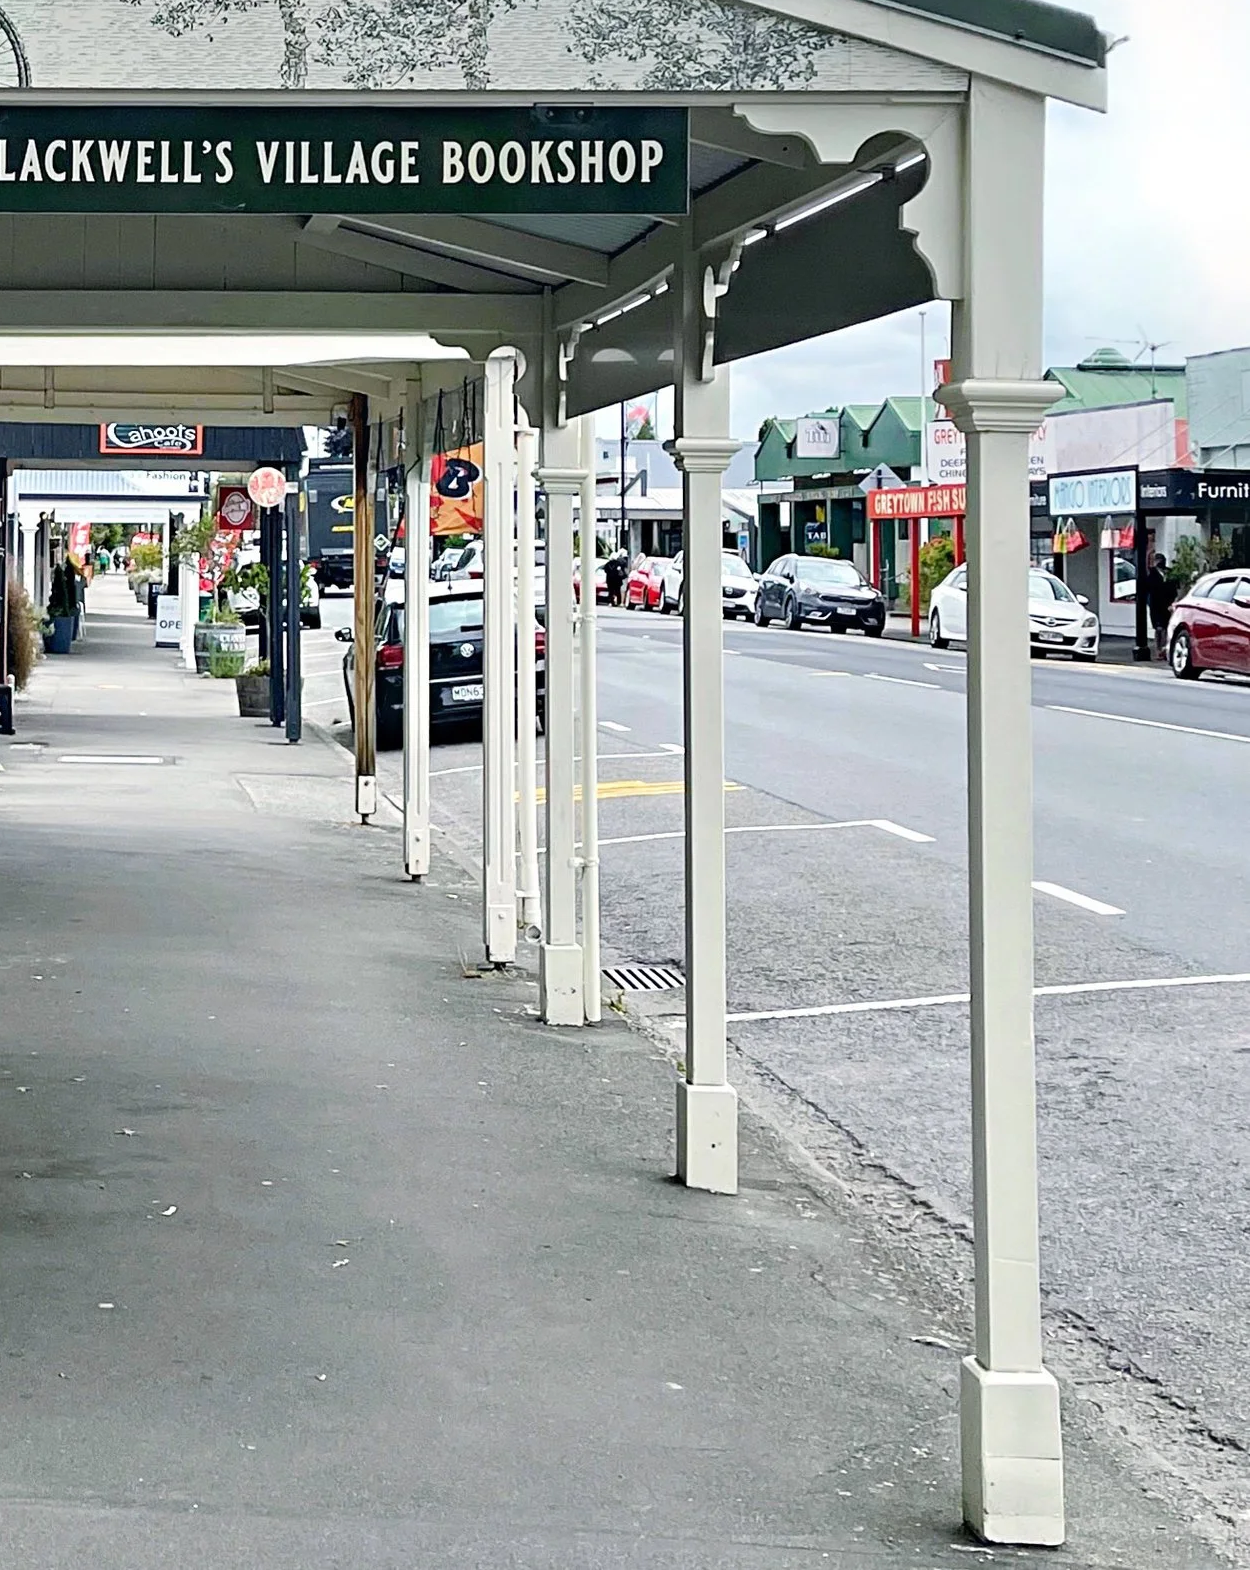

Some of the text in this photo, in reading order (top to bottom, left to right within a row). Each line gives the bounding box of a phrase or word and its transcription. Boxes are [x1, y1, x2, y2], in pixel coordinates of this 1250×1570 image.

[256, 141, 422, 185] VILLAGE
[442, 141, 665, 185] BOOKSHOP
[107, 423, 196, 451] Cahoots
[875, 491, 925, 514] GREYTOWN
[928, 489, 950, 512] FISH
[806, 531, 827, 540] TAB
